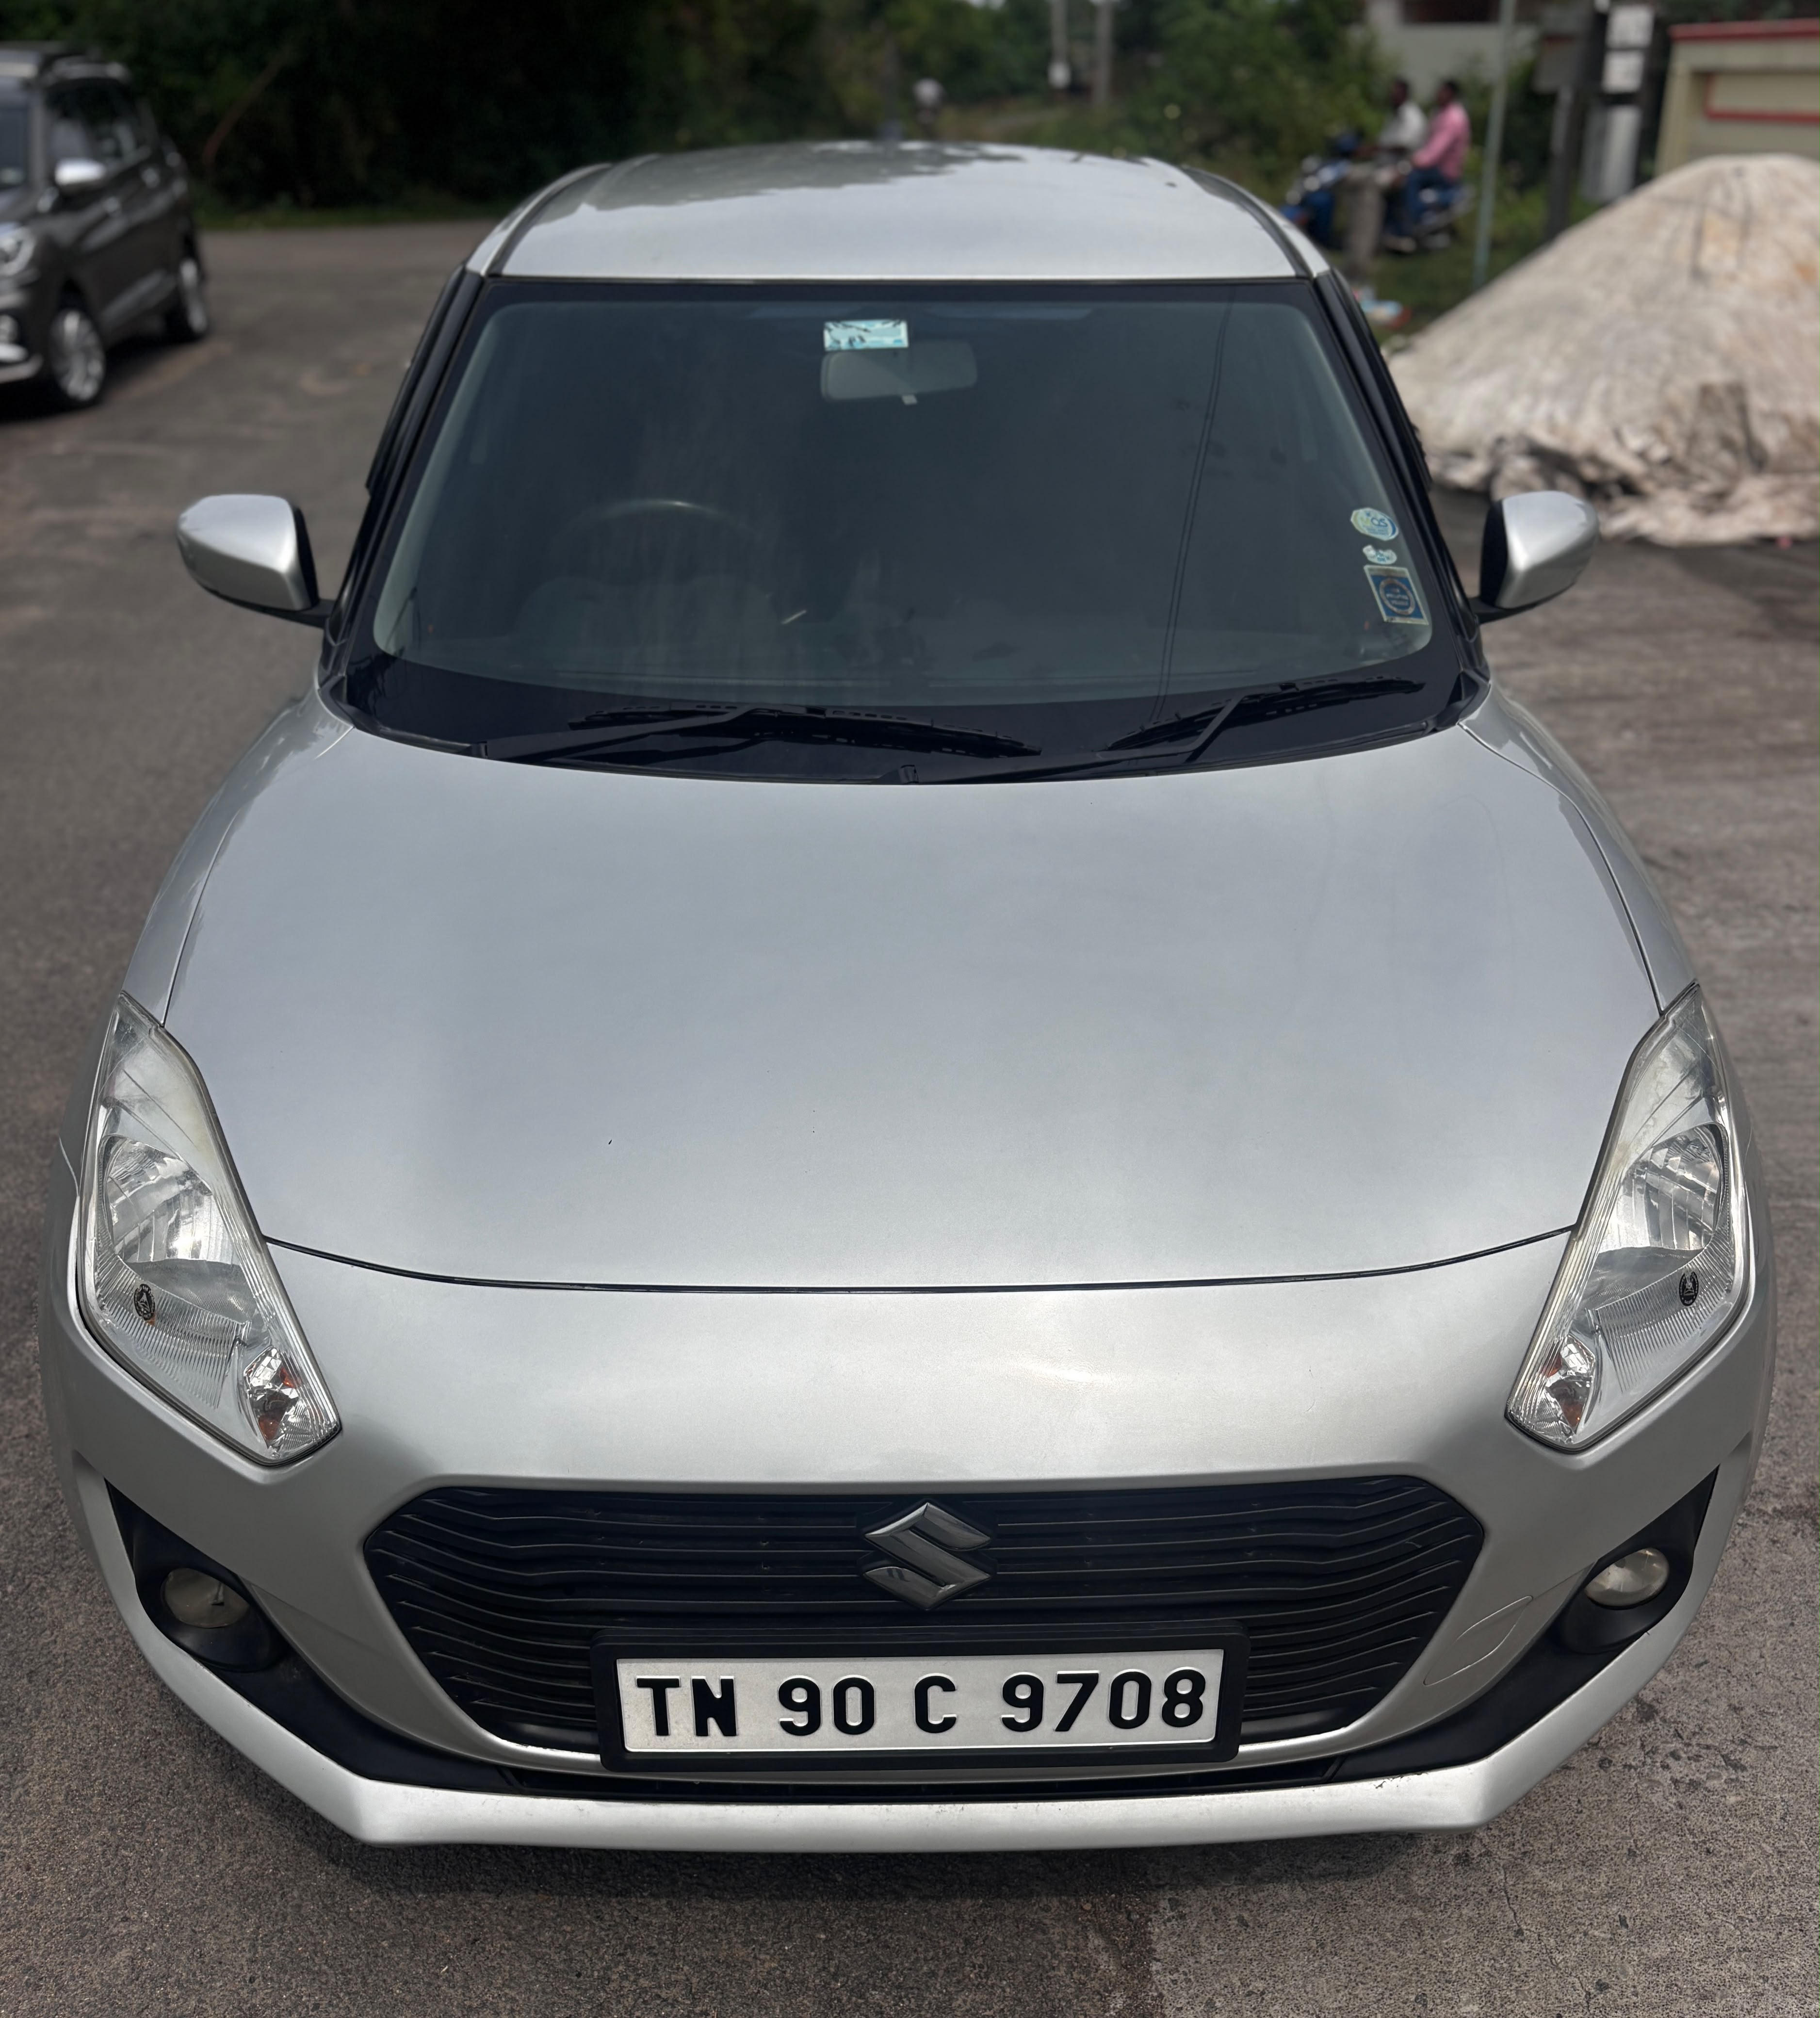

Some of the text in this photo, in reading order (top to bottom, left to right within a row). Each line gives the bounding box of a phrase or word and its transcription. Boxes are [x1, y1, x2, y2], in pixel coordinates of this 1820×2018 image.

[636, 1669, 1206, 1737] TN 90 C 9708
